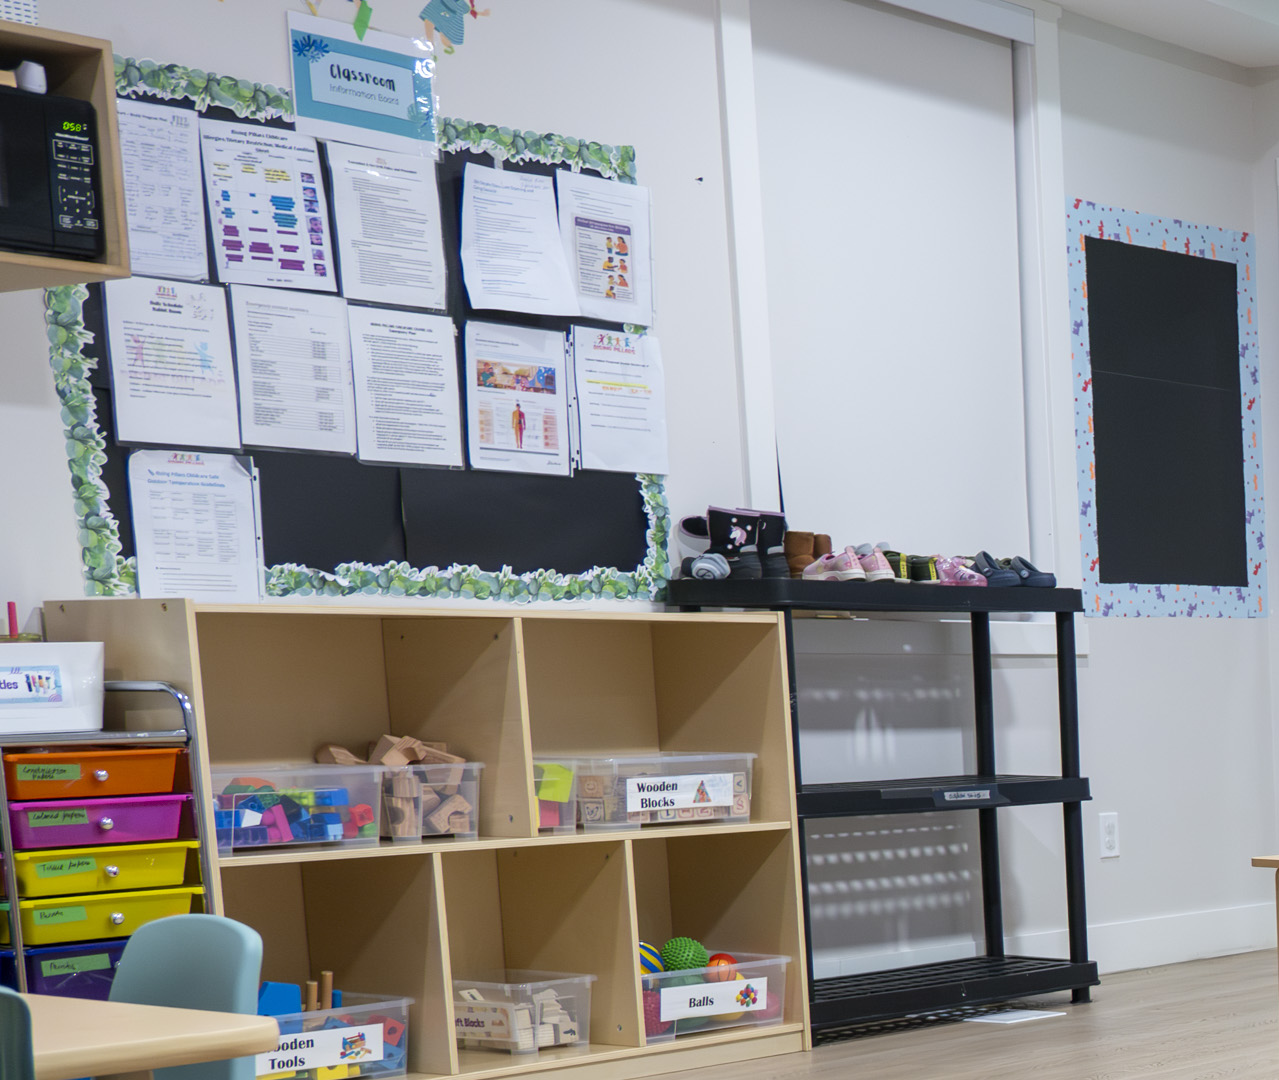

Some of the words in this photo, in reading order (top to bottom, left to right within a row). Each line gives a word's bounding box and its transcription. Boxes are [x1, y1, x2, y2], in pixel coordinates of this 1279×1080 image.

[330, 64, 396, 92] Classroom
[330, 84, 376, 101] Information
[378, 95, 400, 106] Board
[636, 781, 678, 793] Wooden
[640, 798, 675, 809] Blocks
[688, 996, 714, 1008] Balls
[464, 1017, 485, 1029] Blocks
[268, 1038, 315, 1053] oden
[269, 1054, 306, 1071] Tools
